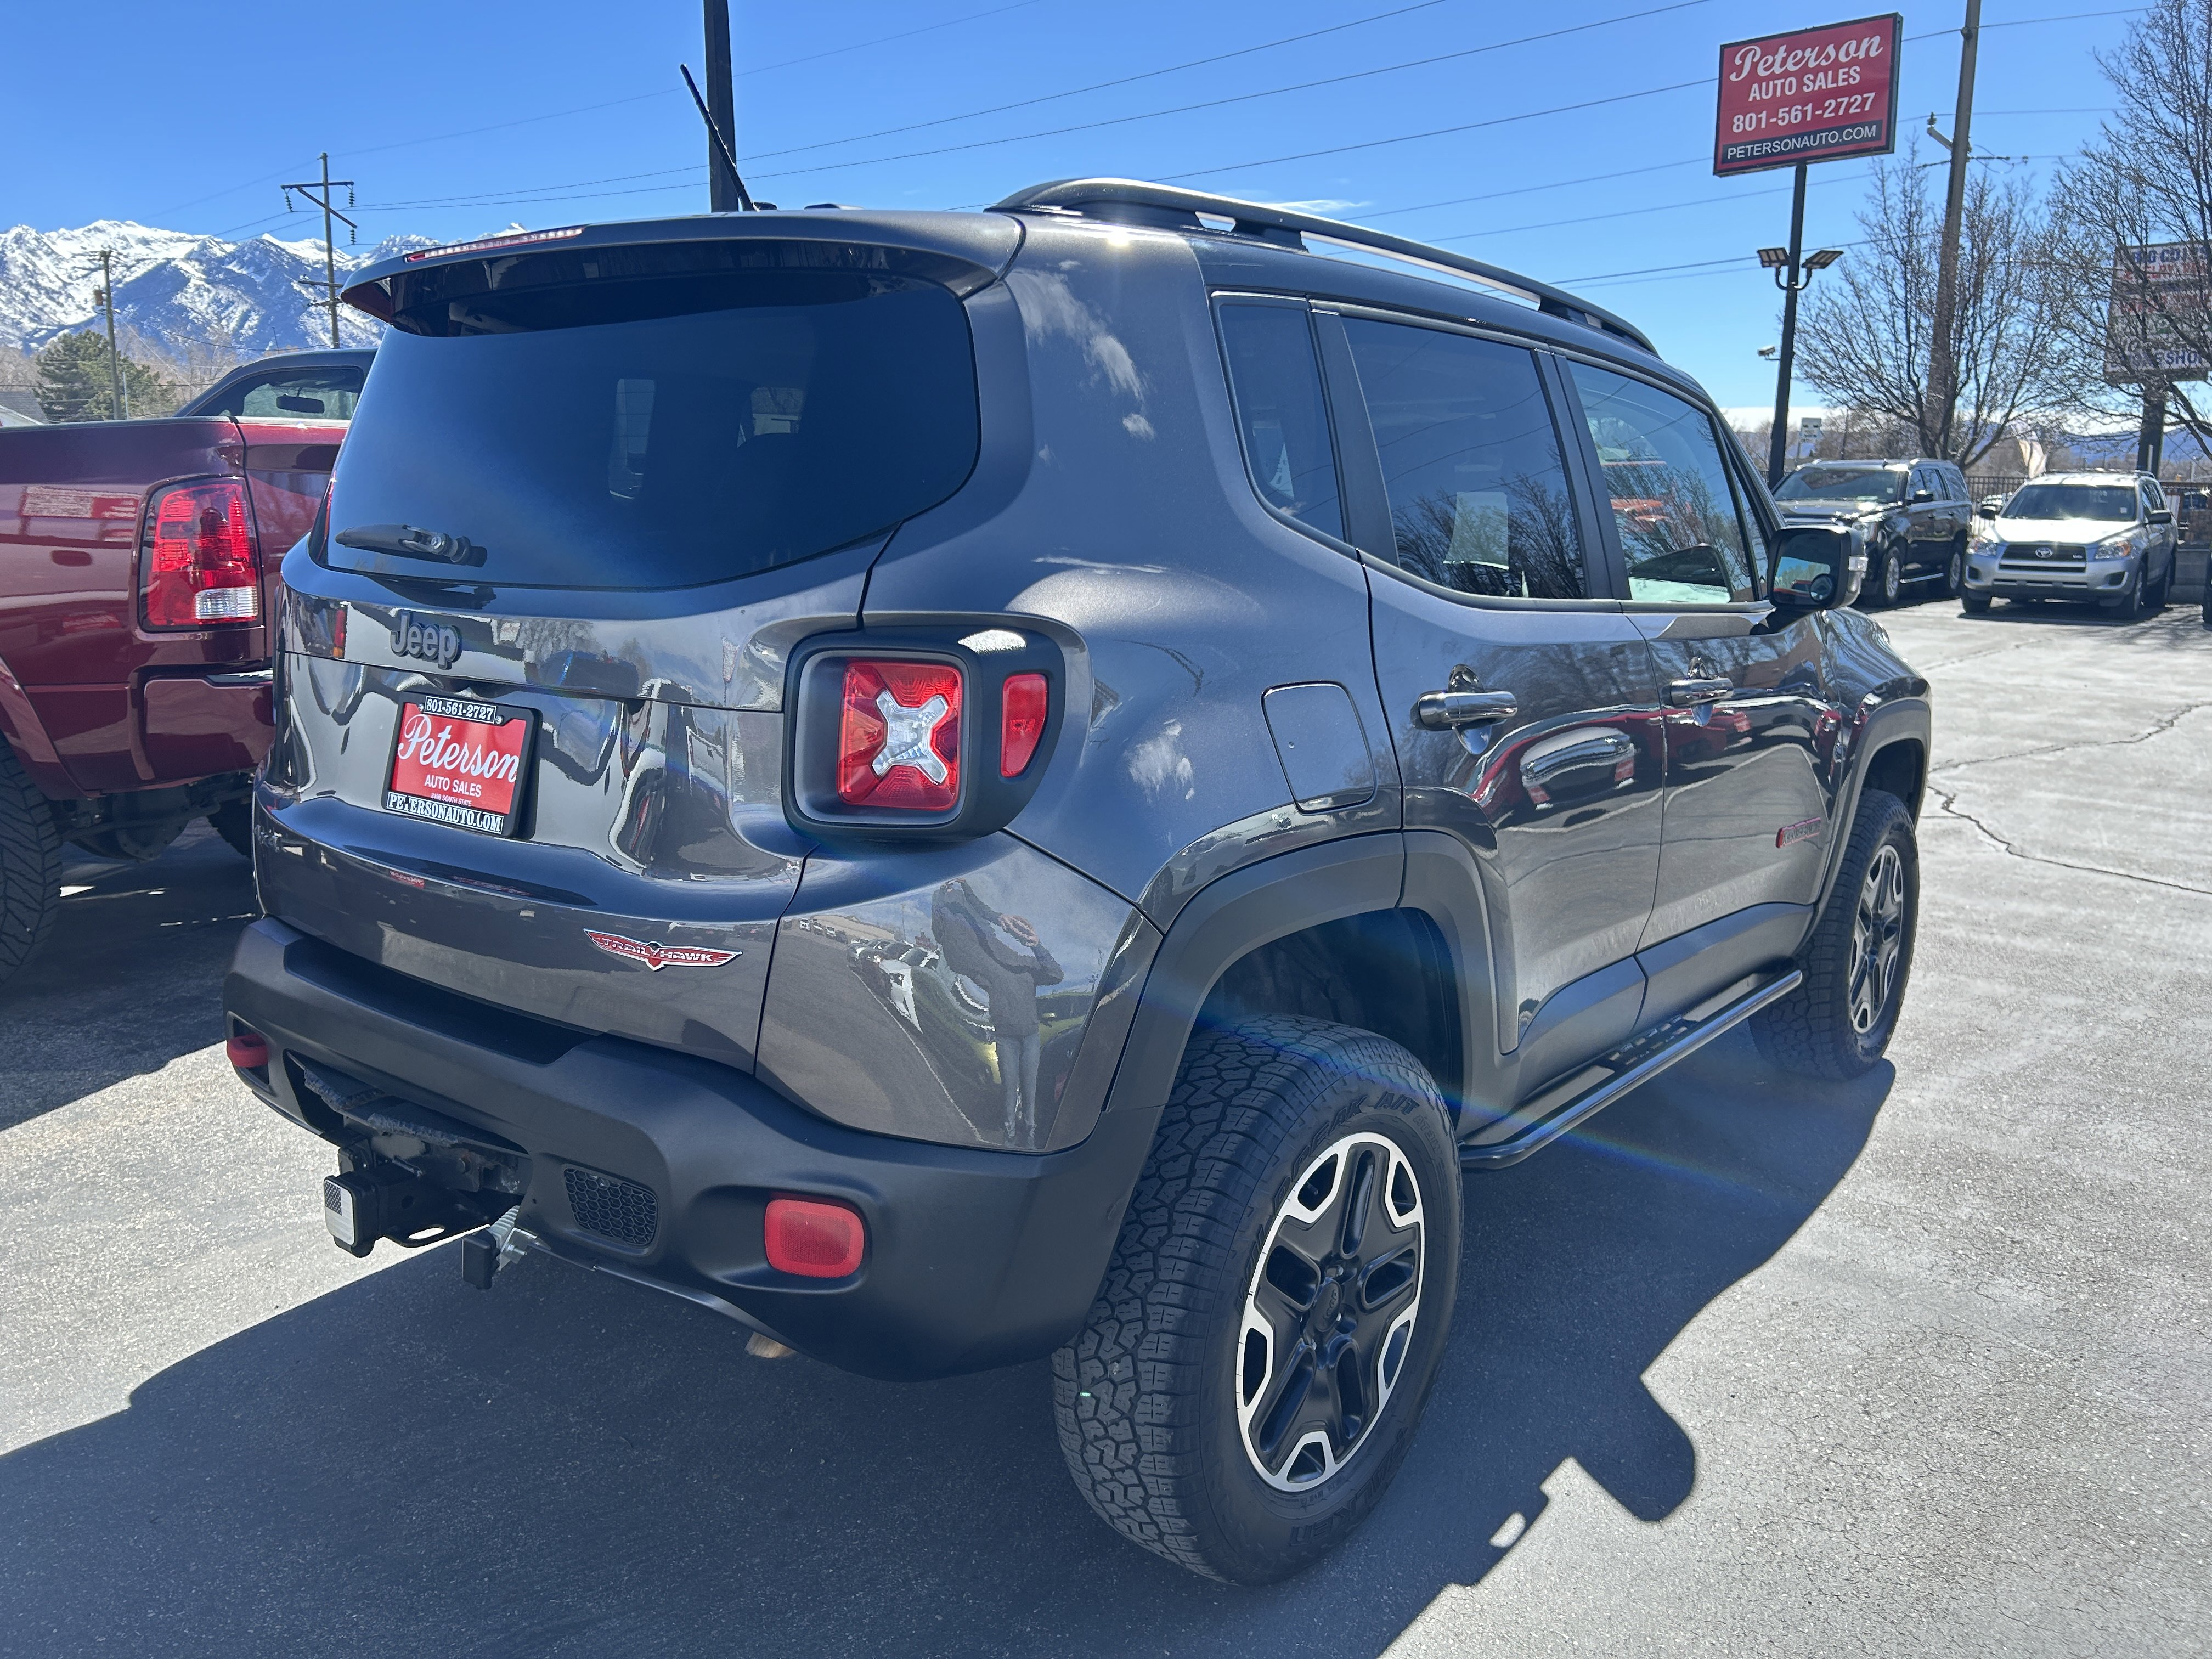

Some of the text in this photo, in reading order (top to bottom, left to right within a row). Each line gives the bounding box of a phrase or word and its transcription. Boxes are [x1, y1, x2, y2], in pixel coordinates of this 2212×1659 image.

[1729, 35, 1883, 82] Peterson
[1748, 65, 1861, 101] AUTO SALES
[1732, 92, 1876, 133] 801-561-2727
[1727, 125, 1876, 160] PETERSONAUTO.COM
[391, 611, 462, 670] Jeep
[426, 698, 494, 720] 801-561-2727
[398, 713, 520, 783] Peterson
[424, 774, 482, 798] AUTO SALES
[442, 794, 458, 804] SOUTH
[458, 798, 472, 806] STATE
